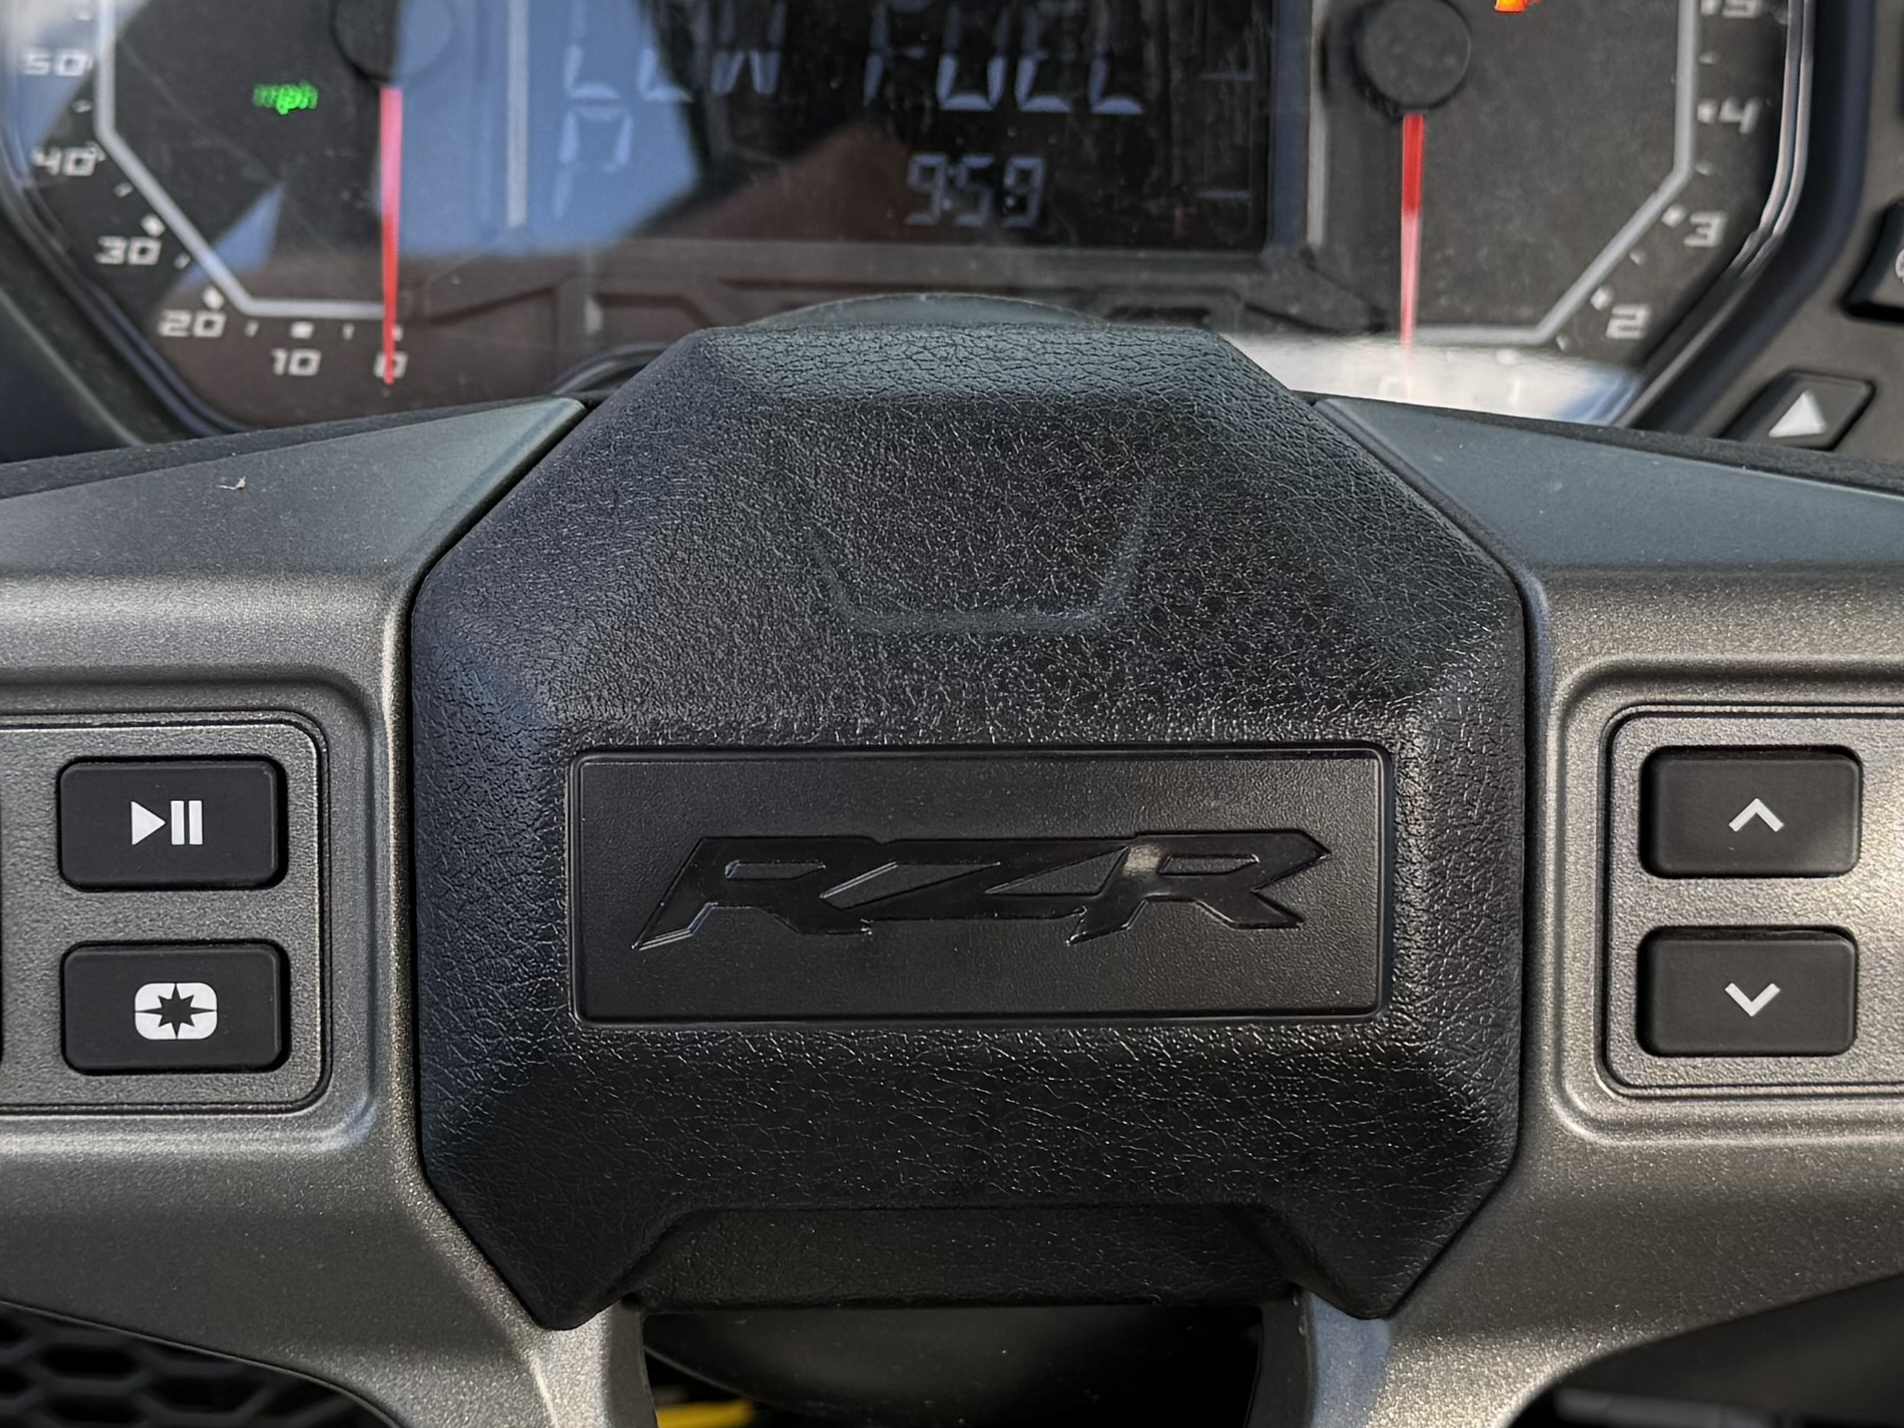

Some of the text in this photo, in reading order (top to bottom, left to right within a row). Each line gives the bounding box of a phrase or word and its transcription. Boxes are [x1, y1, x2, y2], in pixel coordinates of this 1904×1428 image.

[23, 49, 88, 79] 50
[1718, 99, 1759, 134] 4
[32, 146, 97, 178] 40
[1684, 212, 1727, 248] 3
[96, 237, 162, 267] 30
[158, 310, 226, 340] 20
[1606, 304, 1651, 340] 2
[270, 348, 322, 378] 10
[632, 829, 1332, 951] RZR
